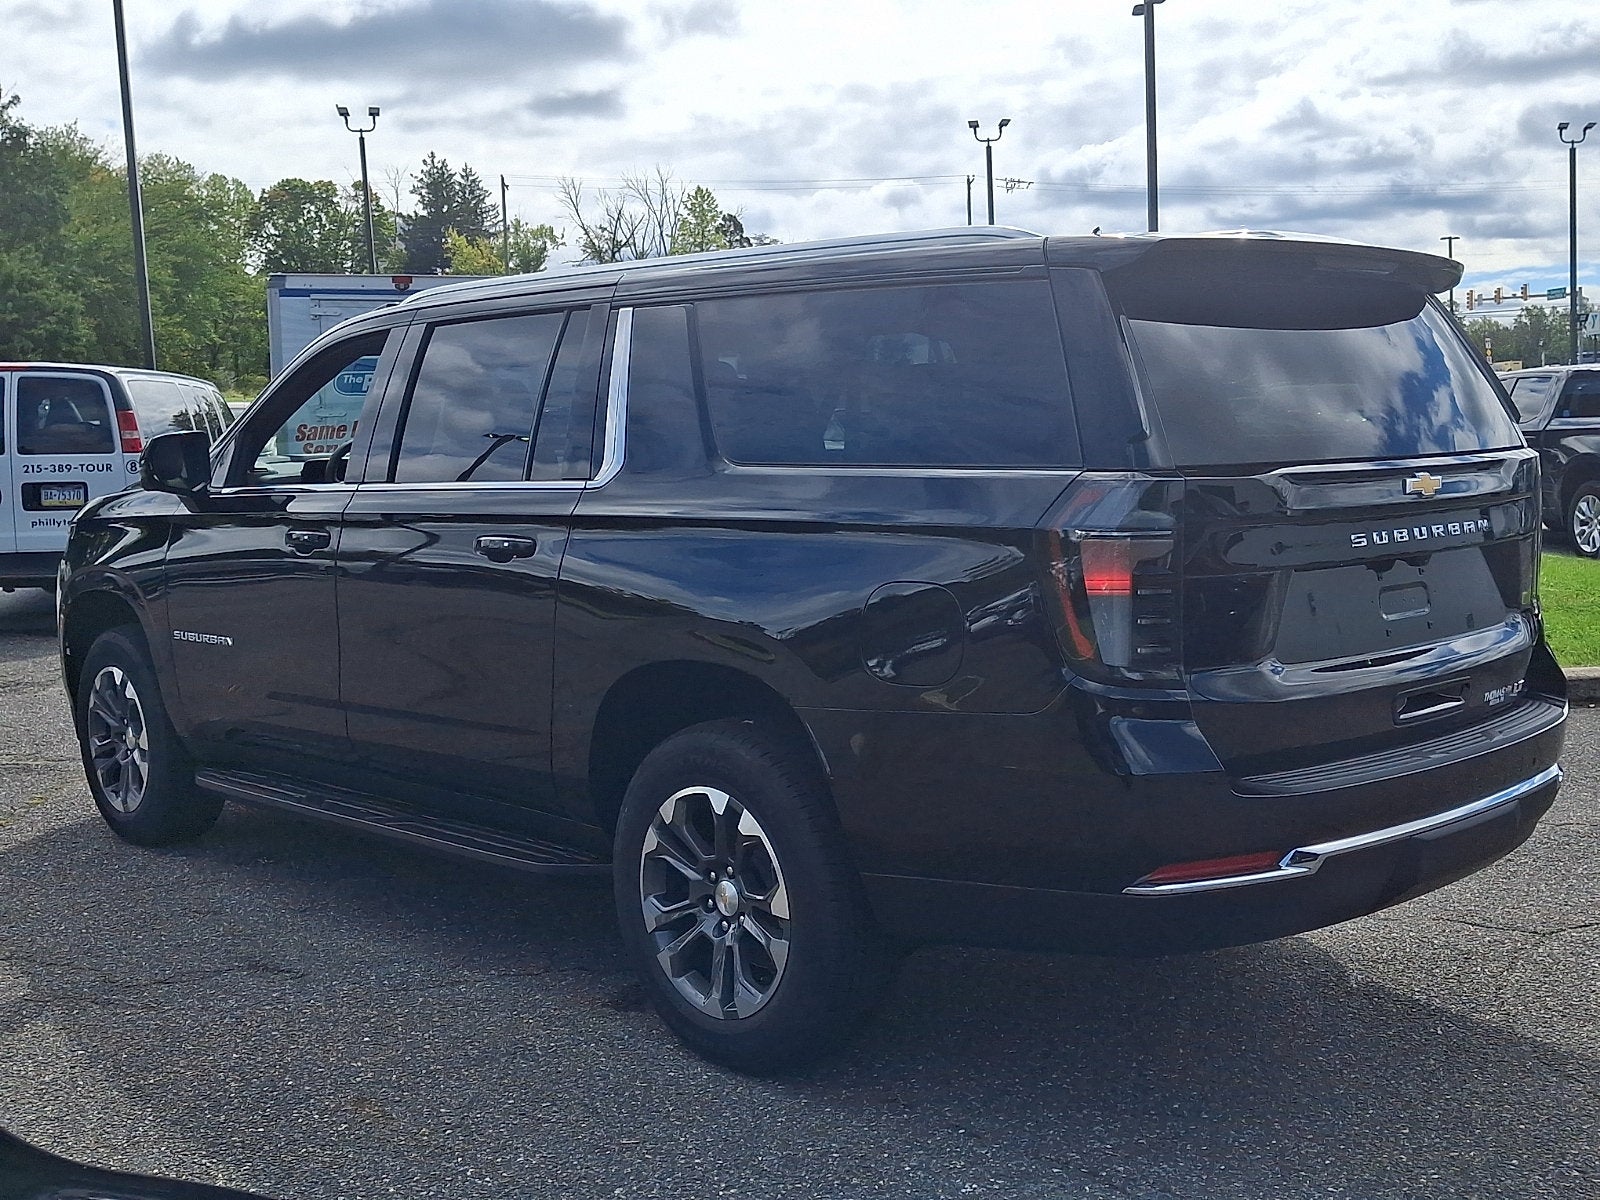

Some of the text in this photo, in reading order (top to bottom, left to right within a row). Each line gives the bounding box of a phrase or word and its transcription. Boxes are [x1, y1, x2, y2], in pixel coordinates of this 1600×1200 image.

[343, 374, 363, 384] The
[295, 423, 348, 442] Same
[23, 463, 113, 474] 215-389-TOUR
[1350, 519, 1489, 548] SUBURBAN
[173, 630, 233, 646] SUBURBAN
